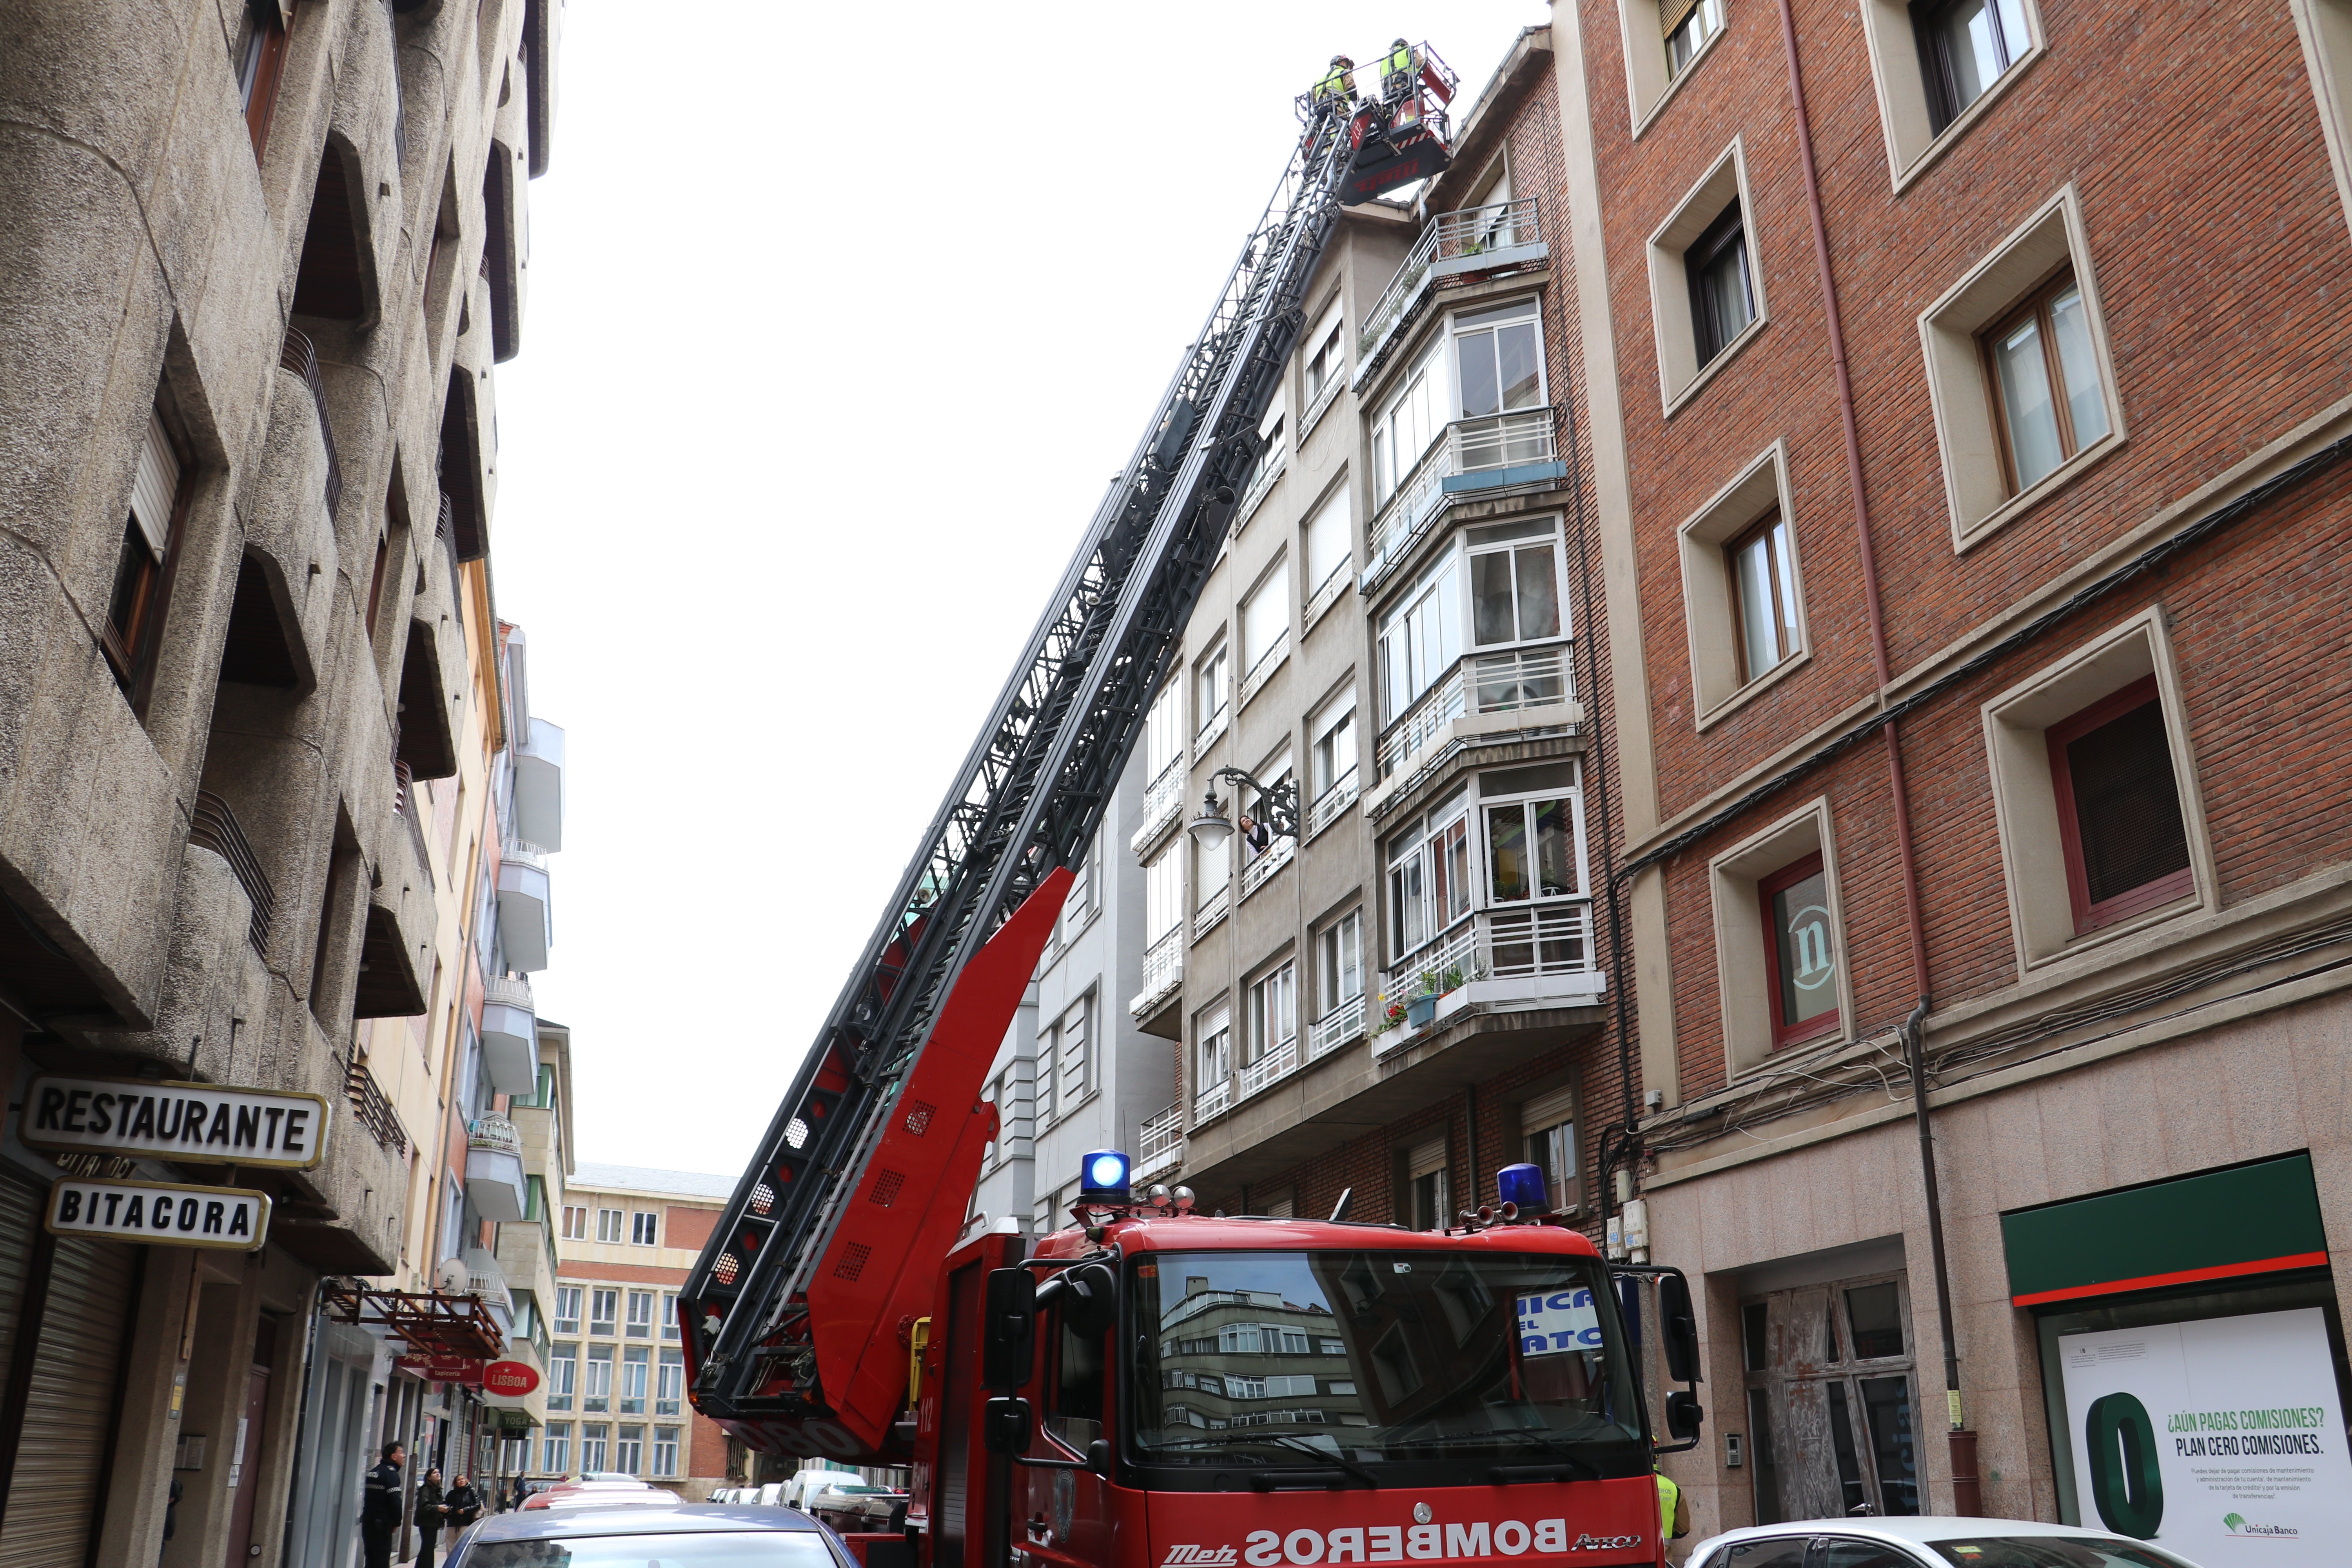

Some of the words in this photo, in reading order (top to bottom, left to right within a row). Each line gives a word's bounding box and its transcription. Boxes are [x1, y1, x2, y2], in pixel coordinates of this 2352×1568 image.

[1353, 122, 1363, 140] L32
[36, 1087, 309, 1151] RESTAURANTE
[59, 1190, 249, 1236] BITACORA
[492, 1374, 527, 1388] LISBOA
[505, 1417, 527, 1425] YOGA
[920, 1397, 933, 1433] 112
[2168, 1410, 2197, 1433] ¿AÚN
[2199, 1411, 2238, 1432] PAGAS
[2239, 1407, 2324, 1430] COMISIONES?
[2176, 1437, 2206, 1456] PLAN
[2208, 1436, 2239, 1456] CERO
[2241, 1434, 2324, 1455] COMISIONES.
[2086, 1392, 2163, 1540] 0
[2245, 1524, 2273, 1535] Unicaja
[2274, 1526, 2298, 1535] Banco
[1160, 1544, 1238, 1567] Metz
